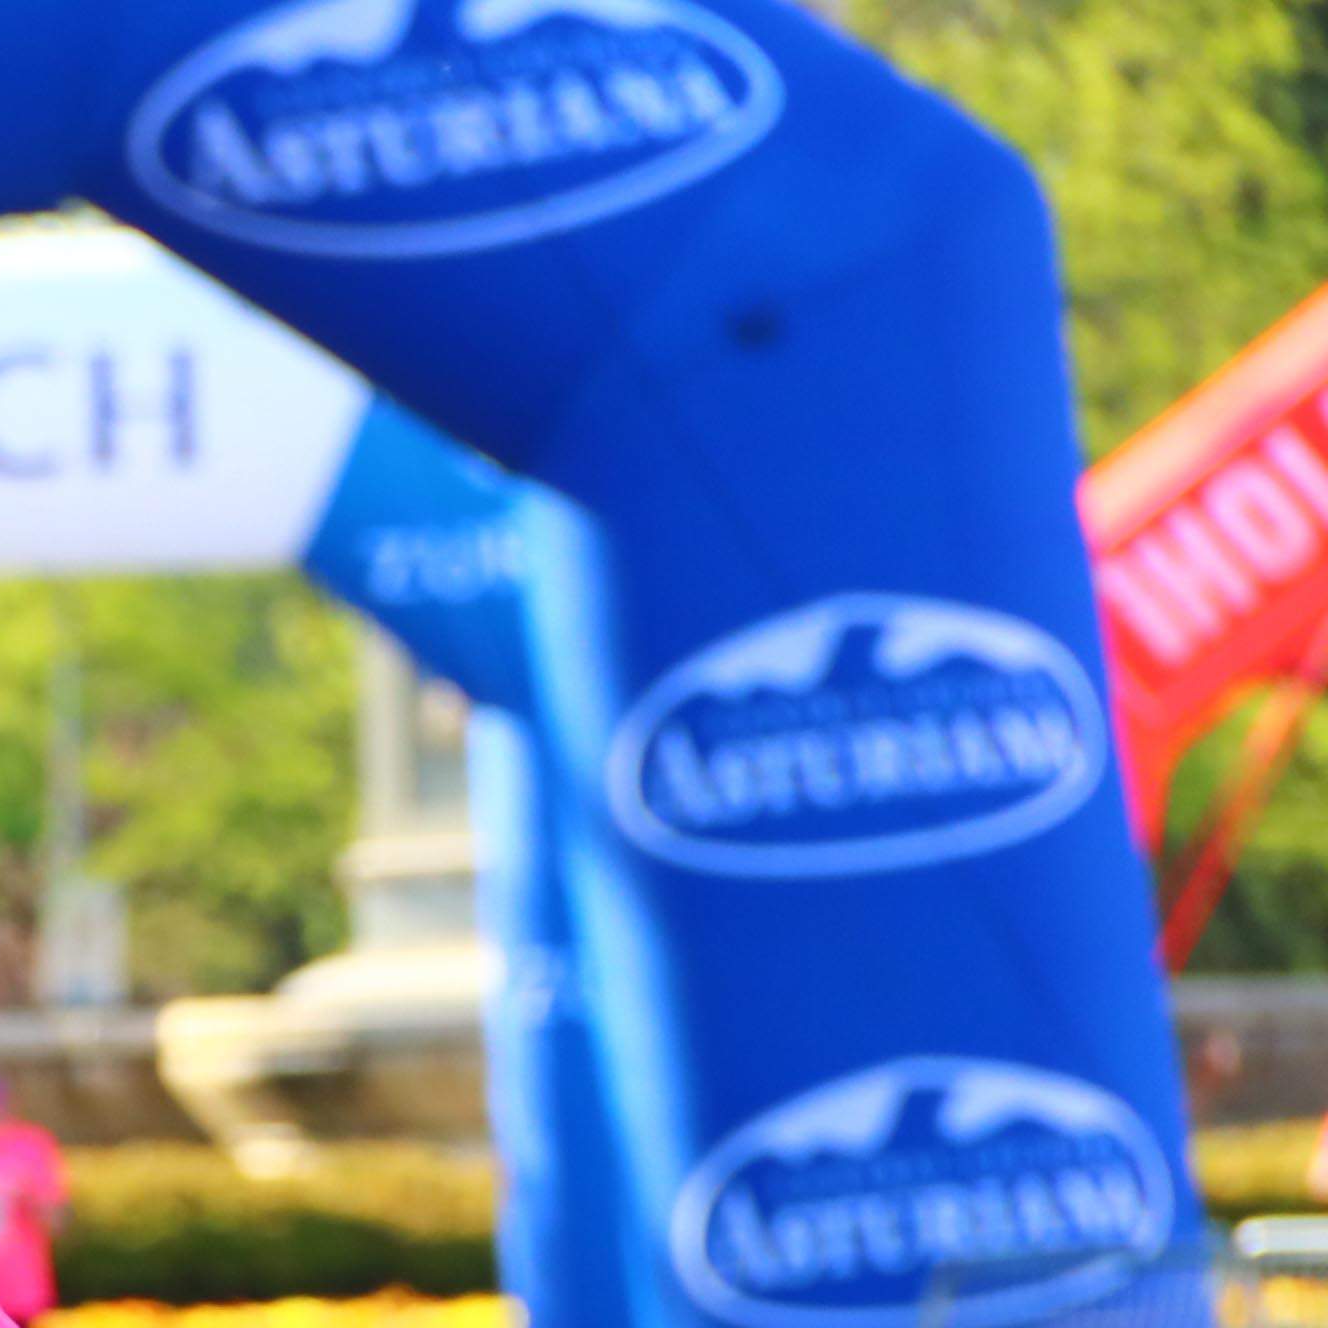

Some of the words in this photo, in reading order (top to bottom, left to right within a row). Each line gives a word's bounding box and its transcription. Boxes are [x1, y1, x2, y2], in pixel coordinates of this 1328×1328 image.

[189, 56, 736, 204] ASTURIANA
[652, 702, 1080, 828] ASTURIANA
[716, 1166, 1146, 1290] ASTURIANA
